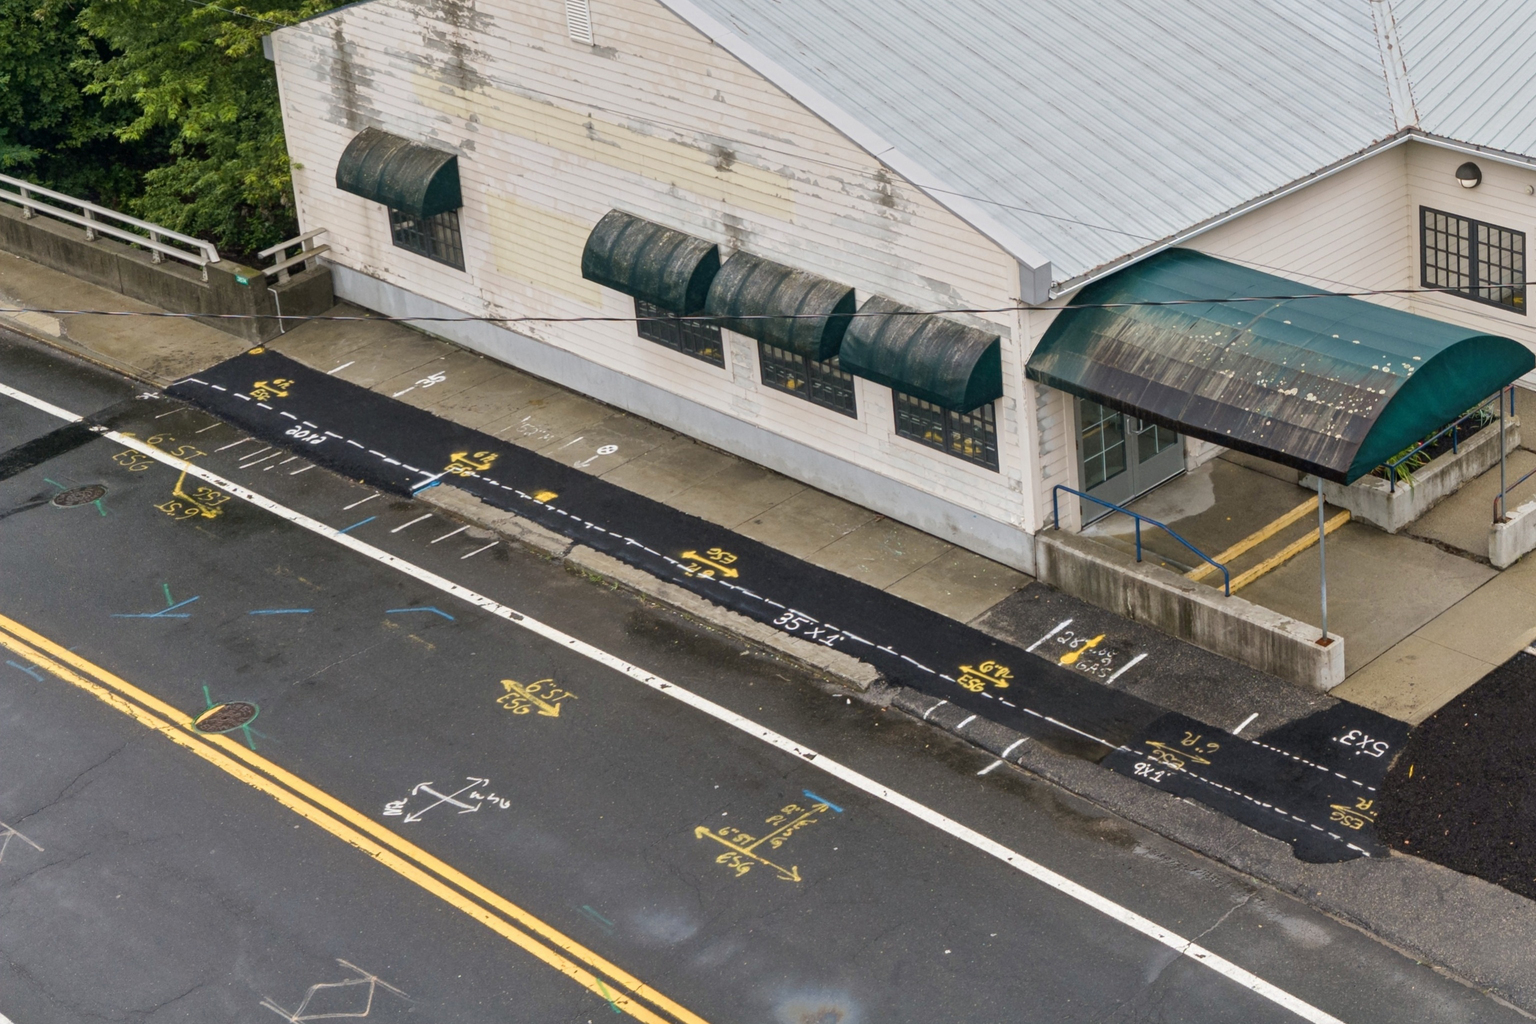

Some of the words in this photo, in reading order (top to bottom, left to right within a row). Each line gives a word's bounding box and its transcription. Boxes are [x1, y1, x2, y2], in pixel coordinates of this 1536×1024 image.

[112, 449, 154, 472] ESG
[957, 674, 986, 692] ESG
[496, 692, 532, 715] ESG
[716, 851, 755, 877] ESG
